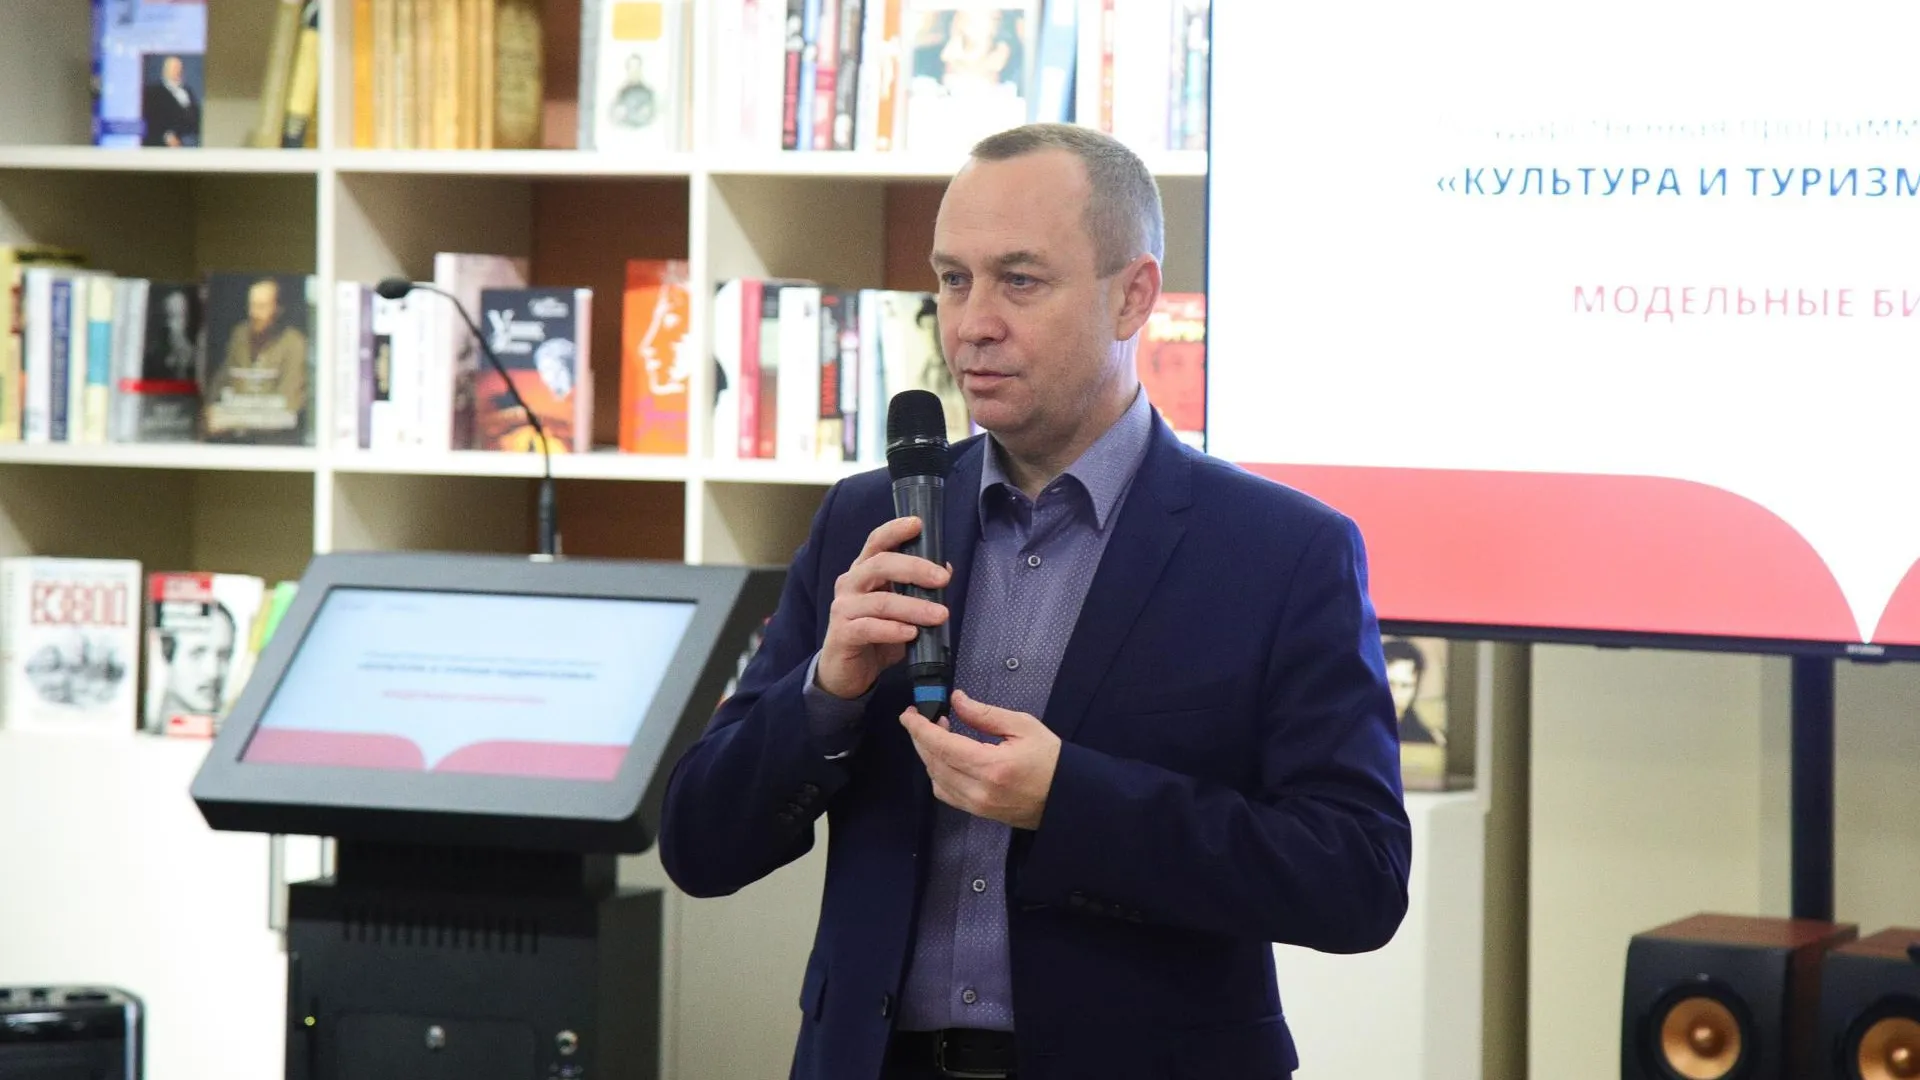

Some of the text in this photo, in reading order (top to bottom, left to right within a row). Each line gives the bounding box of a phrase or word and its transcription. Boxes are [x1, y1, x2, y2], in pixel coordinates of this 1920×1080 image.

[1436, 166, 1920, 199] «КУЛЬТУРА И ТУРИЗМ
[1573, 285, 1854, 323] МОДЕЛЬНЫЕ
